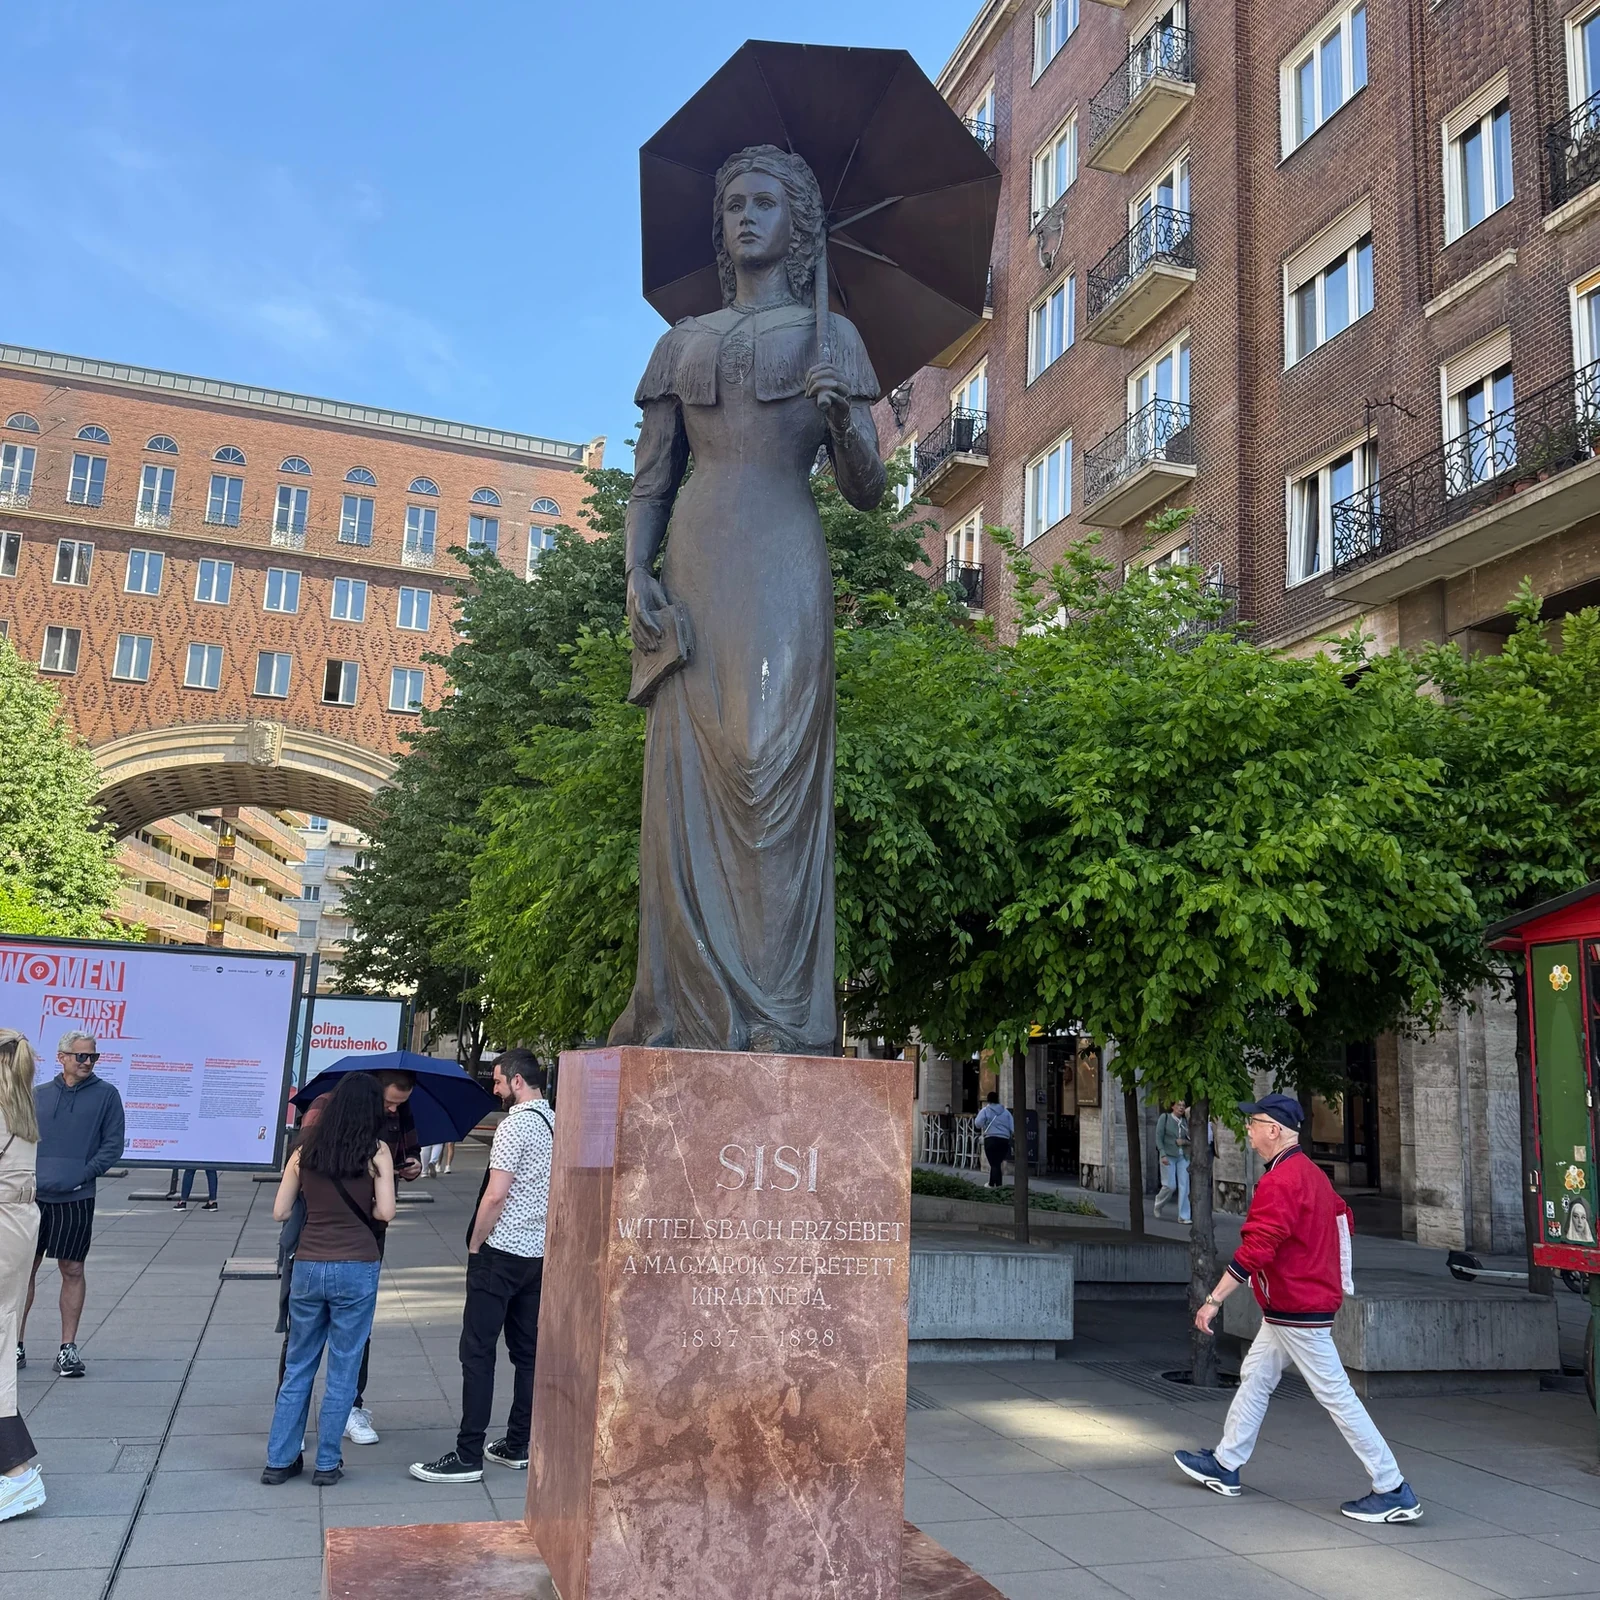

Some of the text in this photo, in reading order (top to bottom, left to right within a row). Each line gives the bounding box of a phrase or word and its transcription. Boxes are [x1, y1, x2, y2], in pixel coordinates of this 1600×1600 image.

[0, 953, 122, 990] WOMEN
[43, 996, 124, 1020] AGAINST
[80, 1018, 120, 1039] WAR
[313, 1022, 345, 1036] olina
[311, 1037, 387, 1051] evtushenko
[716, 1143, 819, 1193] SISI
[617, 1218, 782, 1240] WITTELSBACH
[622, 1255, 896, 1276] A MAGYAROK SZERETETT
[681, 1329, 740, 1349] 1837
[779, 1328, 835, 1348] 1898
